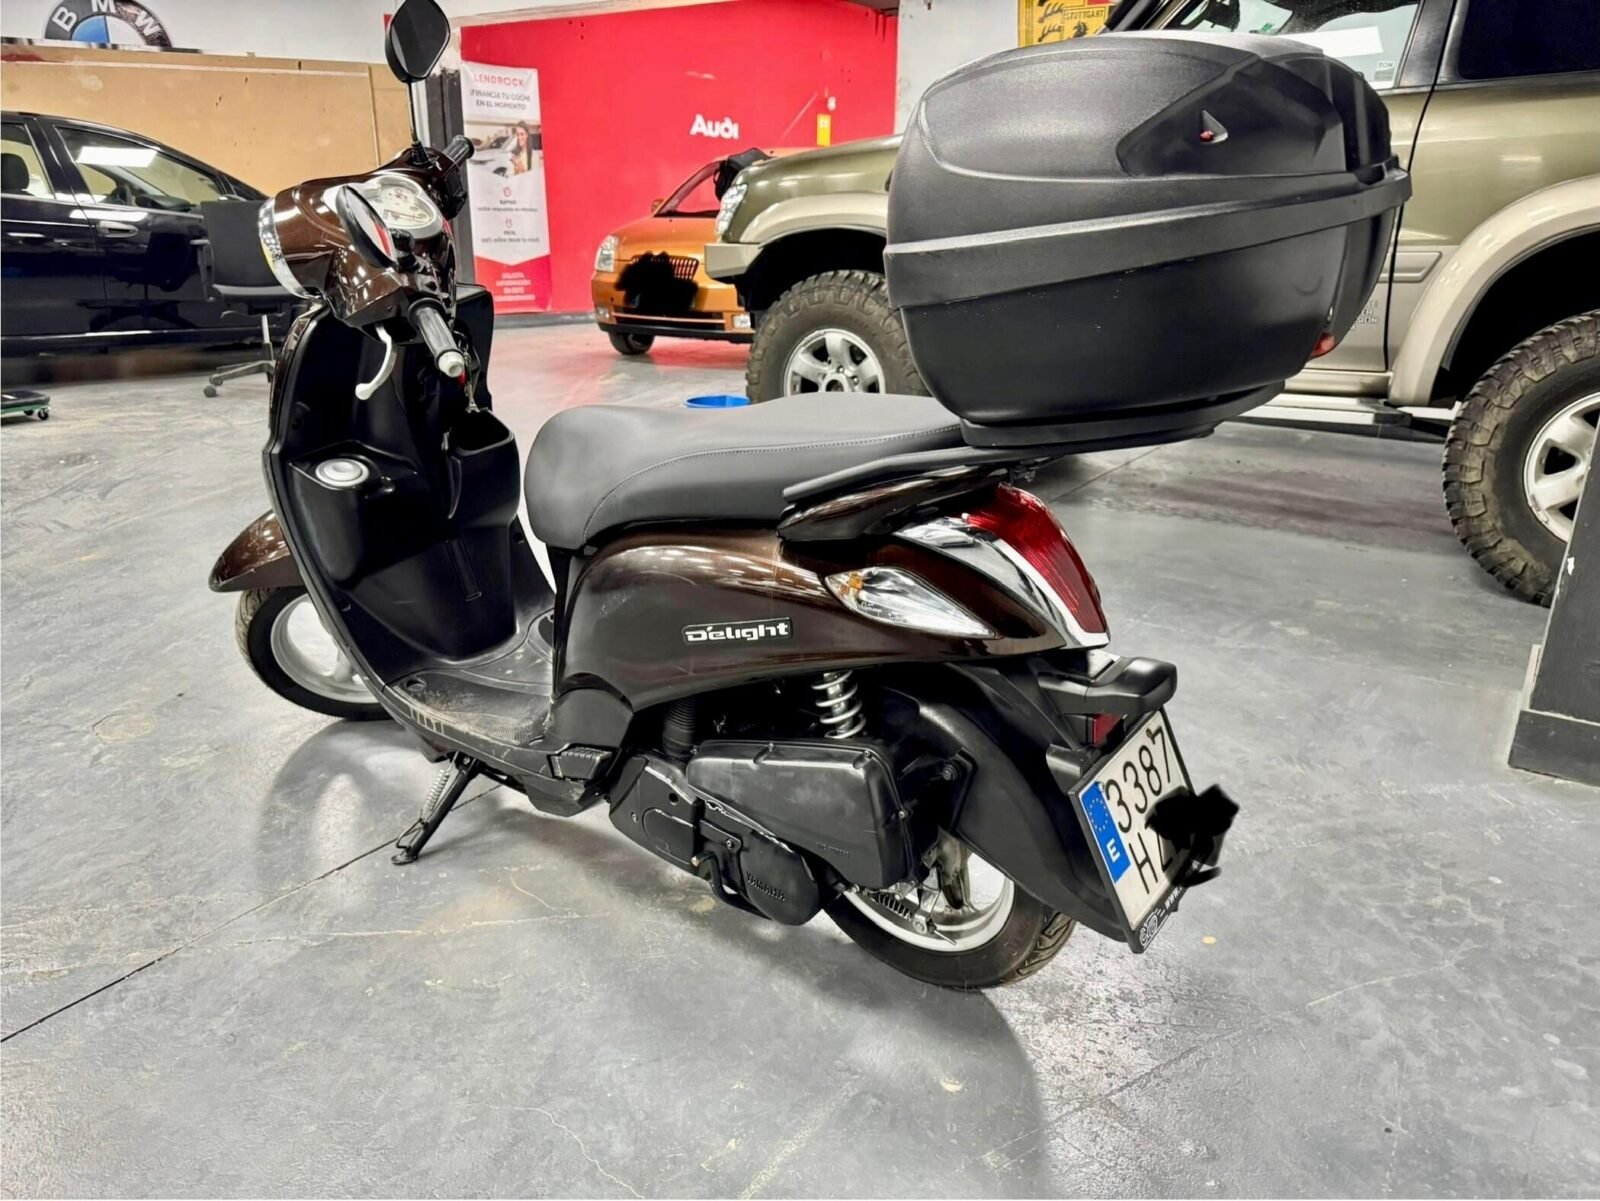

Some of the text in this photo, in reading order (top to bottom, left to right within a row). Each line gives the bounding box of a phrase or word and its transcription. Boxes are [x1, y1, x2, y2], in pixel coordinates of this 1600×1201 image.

[51, 0, 161, 37] BMW
[689, 113, 739, 140] Audi
[1104, 726, 1171, 834] 3387
[1106, 838, 1121, 863] E
